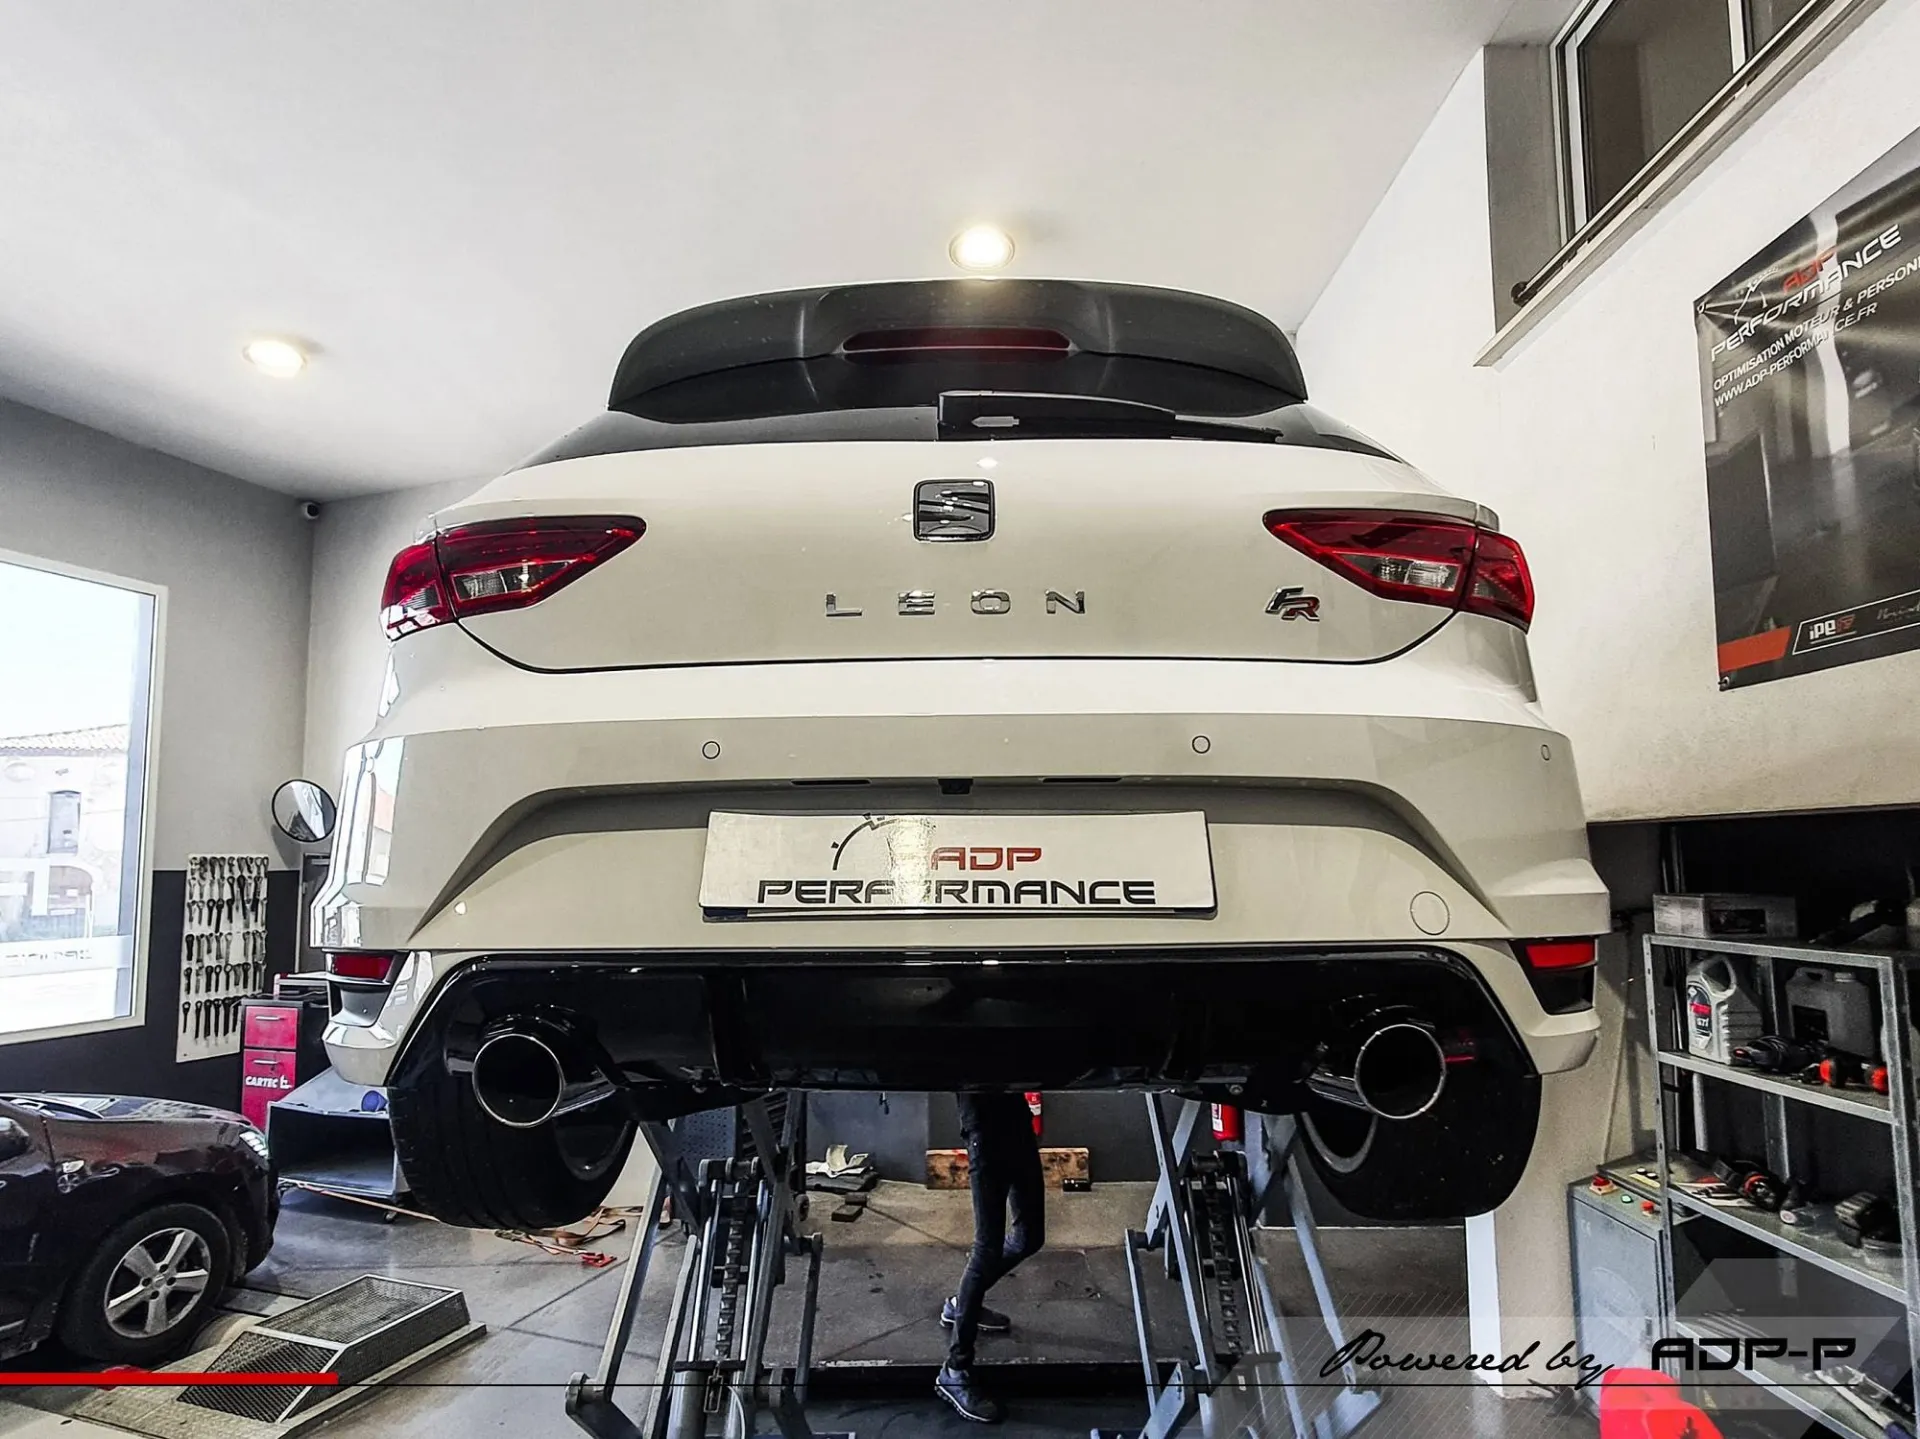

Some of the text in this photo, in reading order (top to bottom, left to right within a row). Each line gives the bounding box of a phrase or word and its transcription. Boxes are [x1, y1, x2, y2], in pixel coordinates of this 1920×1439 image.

[1783, 243, 1838, 295] ADP
[1711, 223, 1902, 362] PERFORMANCE
[1713, 255, 1920, 391] OPTIMISATION MOTEUR & PERSON
[826, 584, 1321, 622] LEON FR
[930, 847, 1042, 871] ADP
[758, 879, 1156, 904] PERFRMANCE
[245, 1075, 279, 1089] CARTEC
